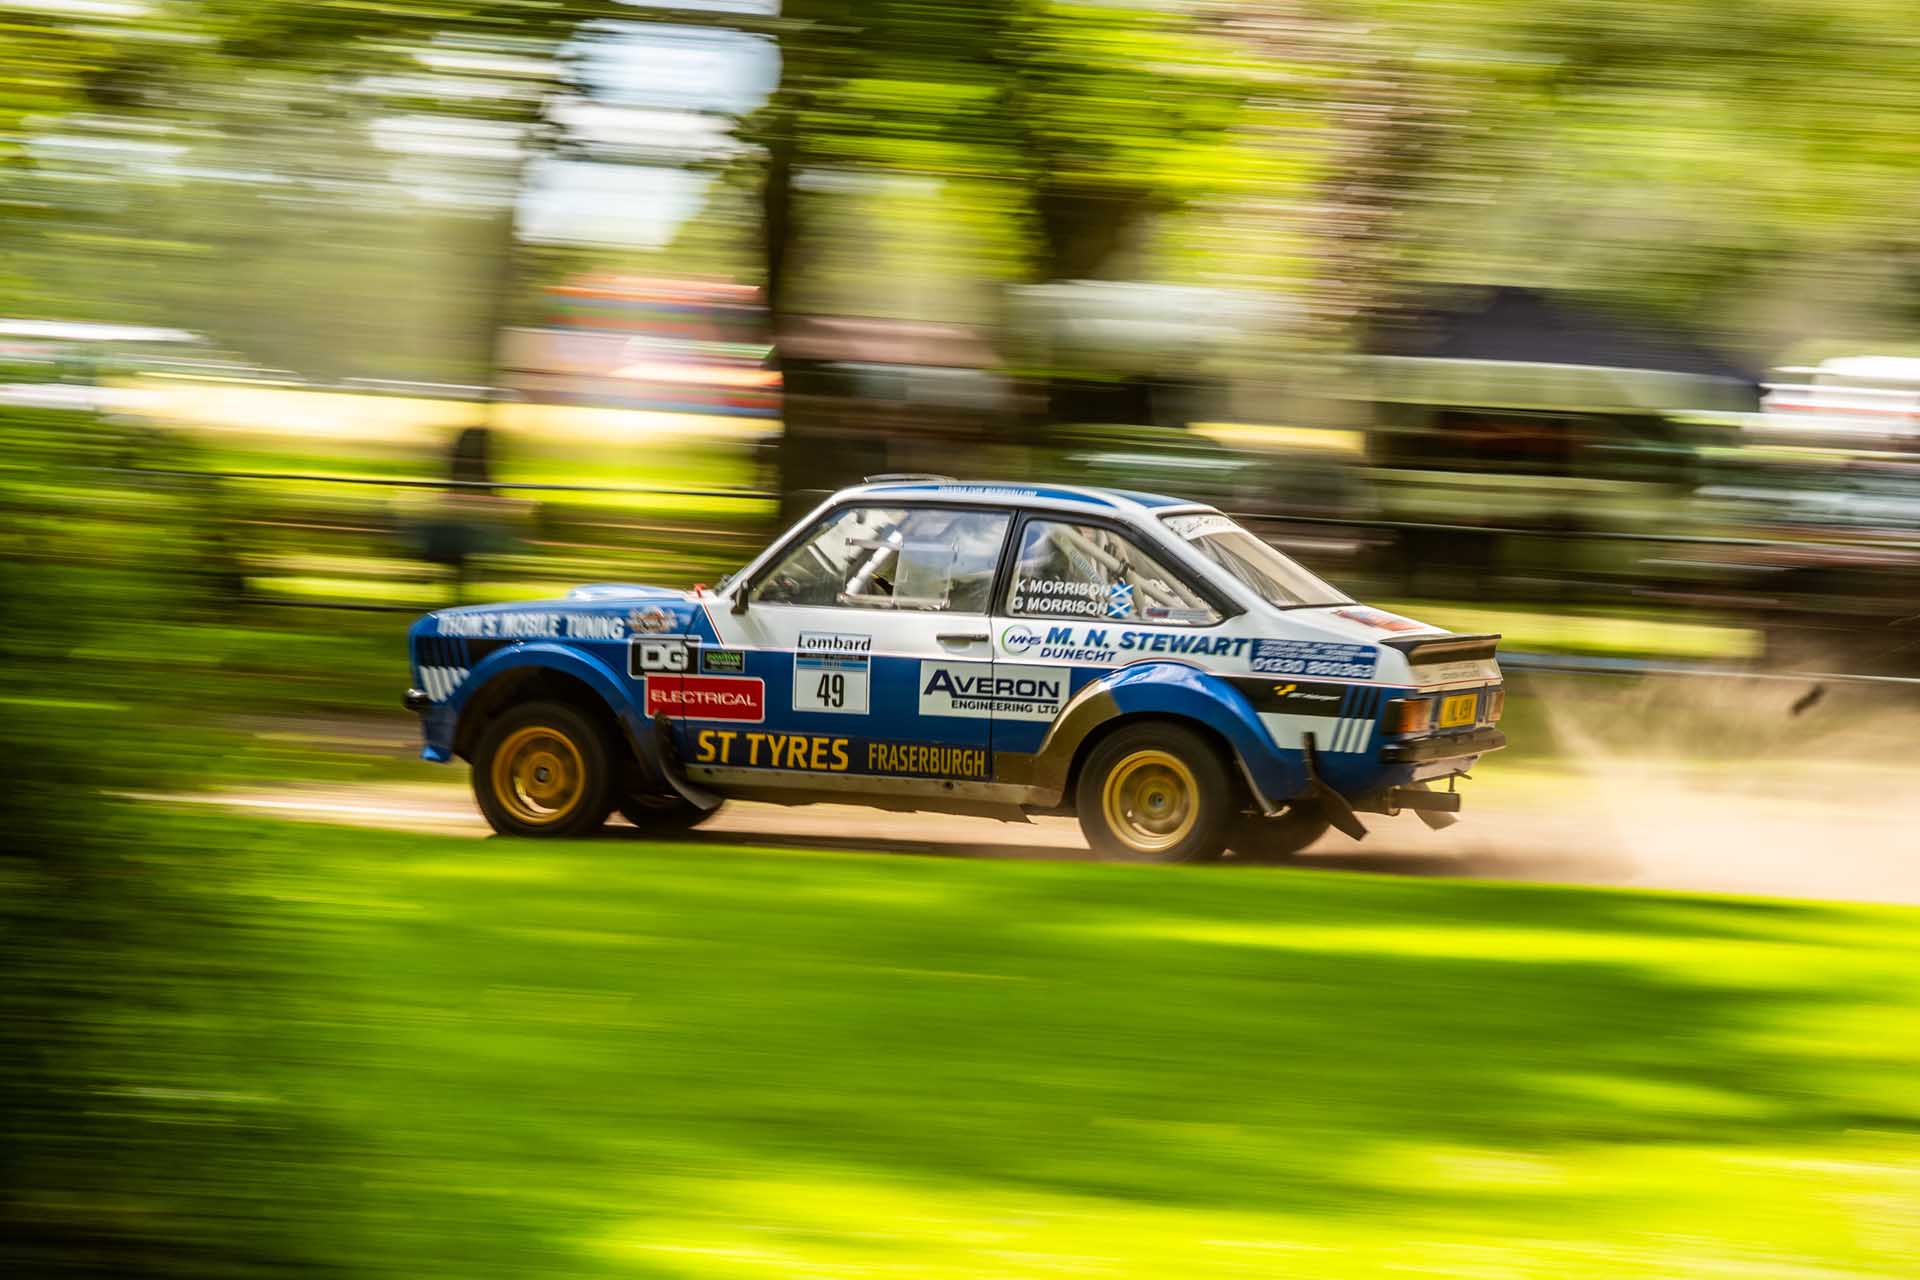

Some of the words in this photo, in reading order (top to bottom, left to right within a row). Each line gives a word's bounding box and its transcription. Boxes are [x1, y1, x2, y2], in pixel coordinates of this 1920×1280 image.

[1015, 579, 1026, 592] K
[1029, 580, 1111, 598] MORRISON
[1026, 597, 1109, 614] MORRISON
[502, 613, 560, 638] MOBILE
[566, 614, 625, 640] TUNING
[797, 634, 871, 651] Lombard
[1045, 627, 1076, 646] M.
[1084, 629, 1110, 648] N.
[1118, 632, 1249, 657] STEWART
[640, 640, 688, 671] DG
[1040, 648, 1116, 661] DUNECHT
[816, 673, 844, 708] 49
[924, 669, 1060, 699] AVERON
[651, 688, 757, 707] ELECTRICAL
[951, 700, 1034, 713] ENGINEERING
[1037, 704, 1060, 714] LTD
[697, 730, 738, 765] ST
[746, 732, 849, 771] TYRES
[868, 743, 986, 777] FRASERBURGH
